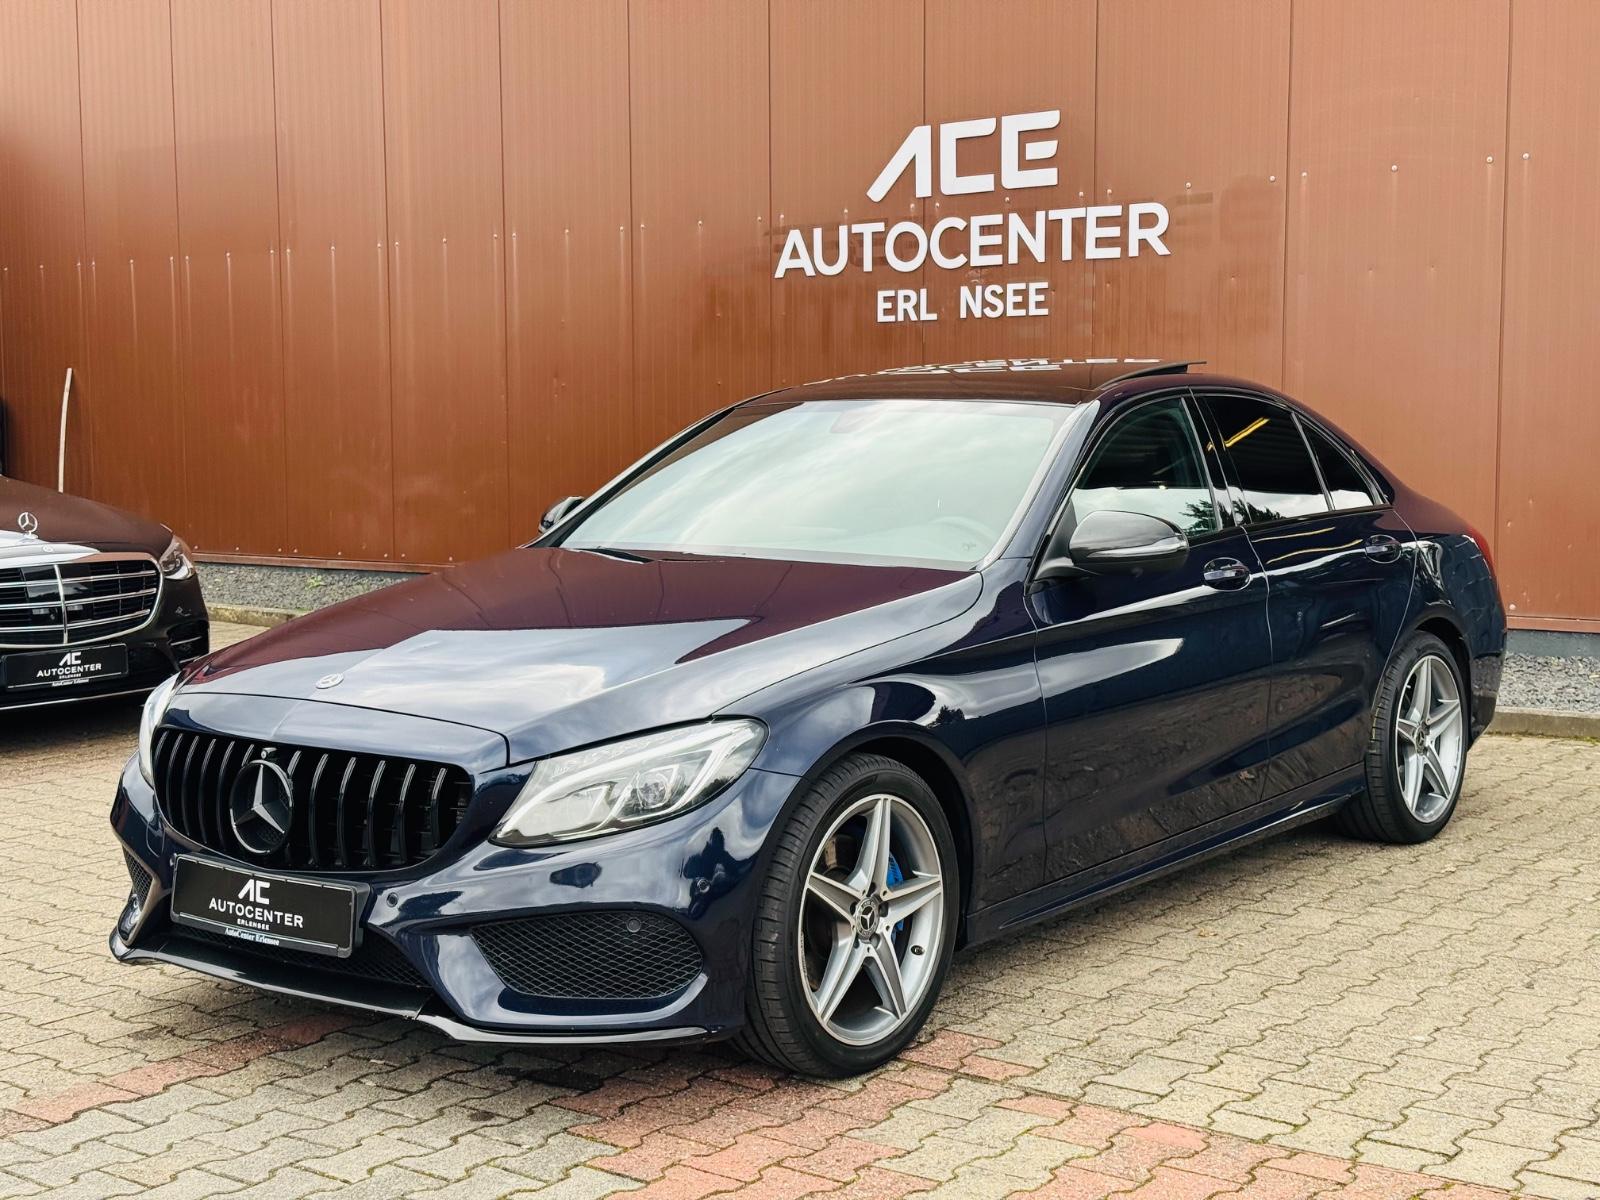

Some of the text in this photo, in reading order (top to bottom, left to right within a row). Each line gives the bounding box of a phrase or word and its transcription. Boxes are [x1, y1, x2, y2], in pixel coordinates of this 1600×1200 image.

[866, 109, 1060, 203] ACE
[774, 202, 1171, 279] AUTOCENTER
[877, 281, 1049, 323] ERL NSEE
[36, 663, 102, 678] AUTOCENTER
[208, 897, 304, 928] AUTOCENTER
[237, 918, 270, 931] ERLENSEE
[225, 928, 255, 941] AutoCenter
